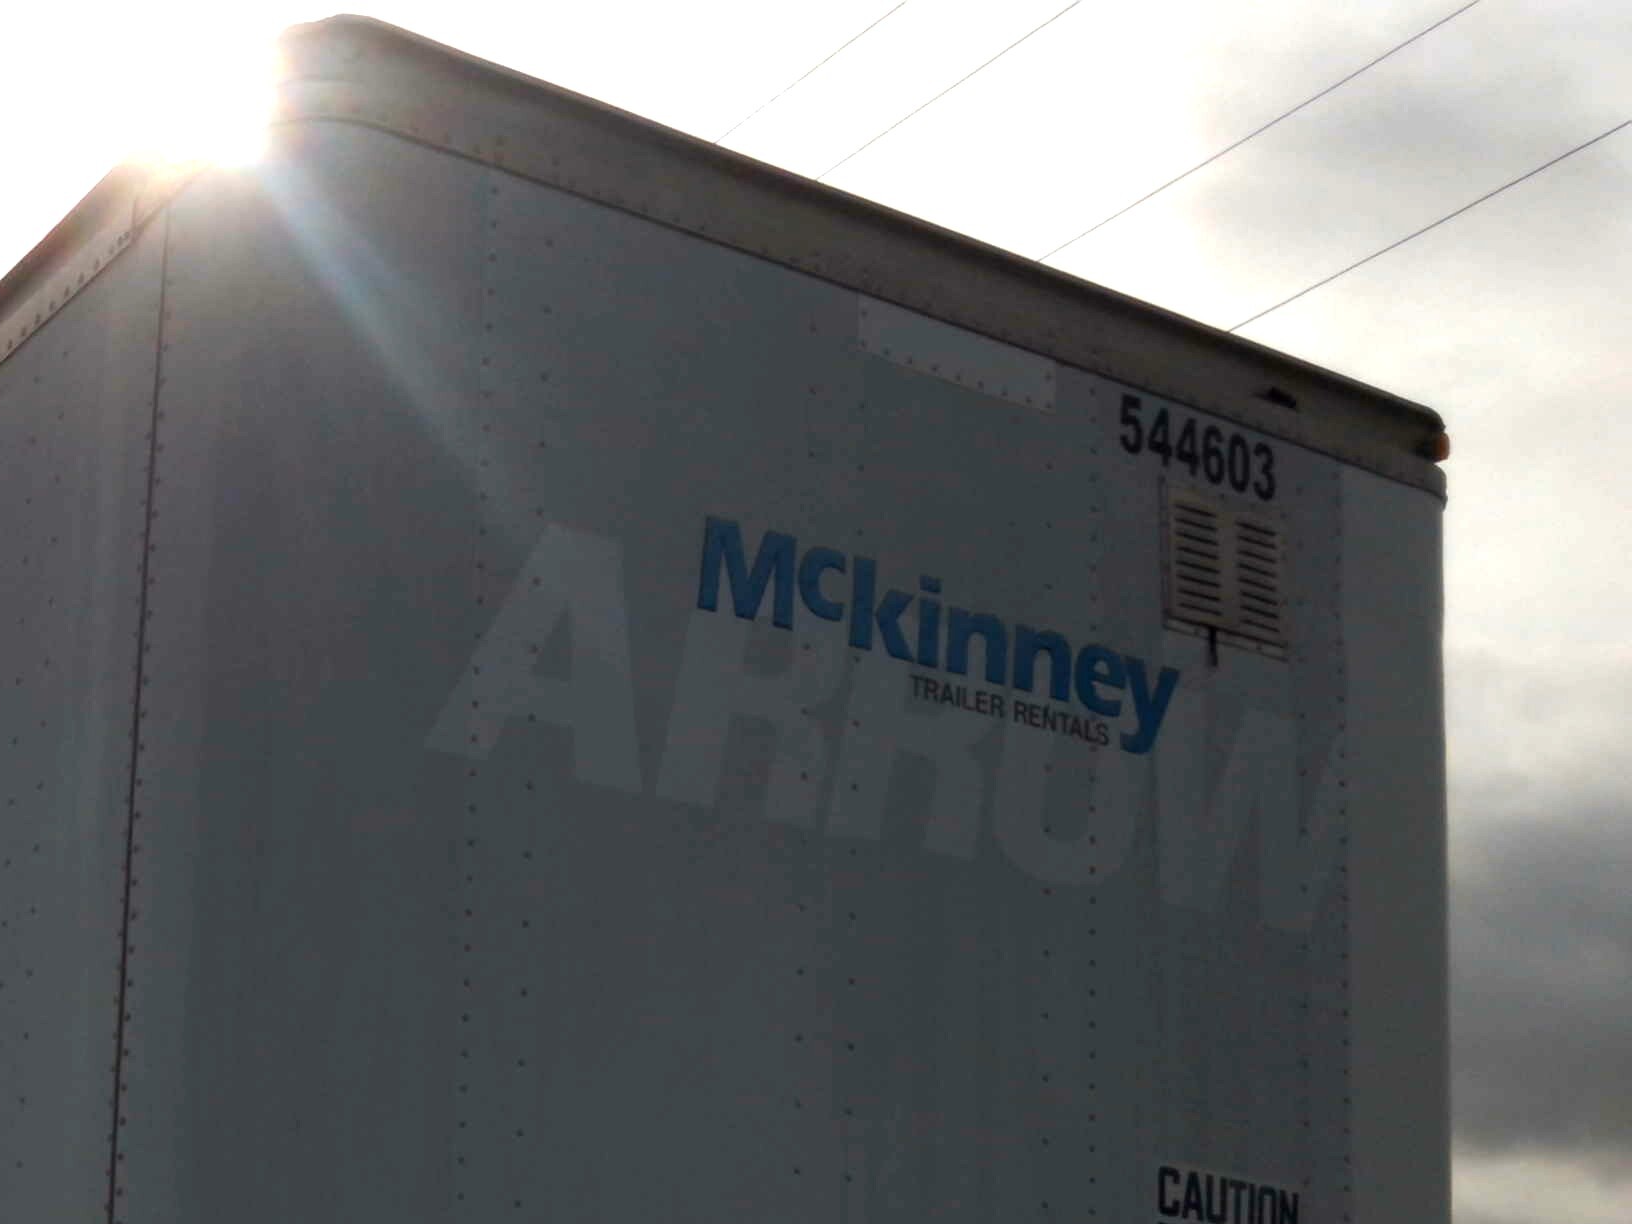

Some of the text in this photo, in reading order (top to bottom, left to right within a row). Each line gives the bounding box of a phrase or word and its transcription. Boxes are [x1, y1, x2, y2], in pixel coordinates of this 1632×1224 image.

[1120, 394, 1276, 502] 544603
[909, 674, 1110, 747] TRAILER RENTALS
